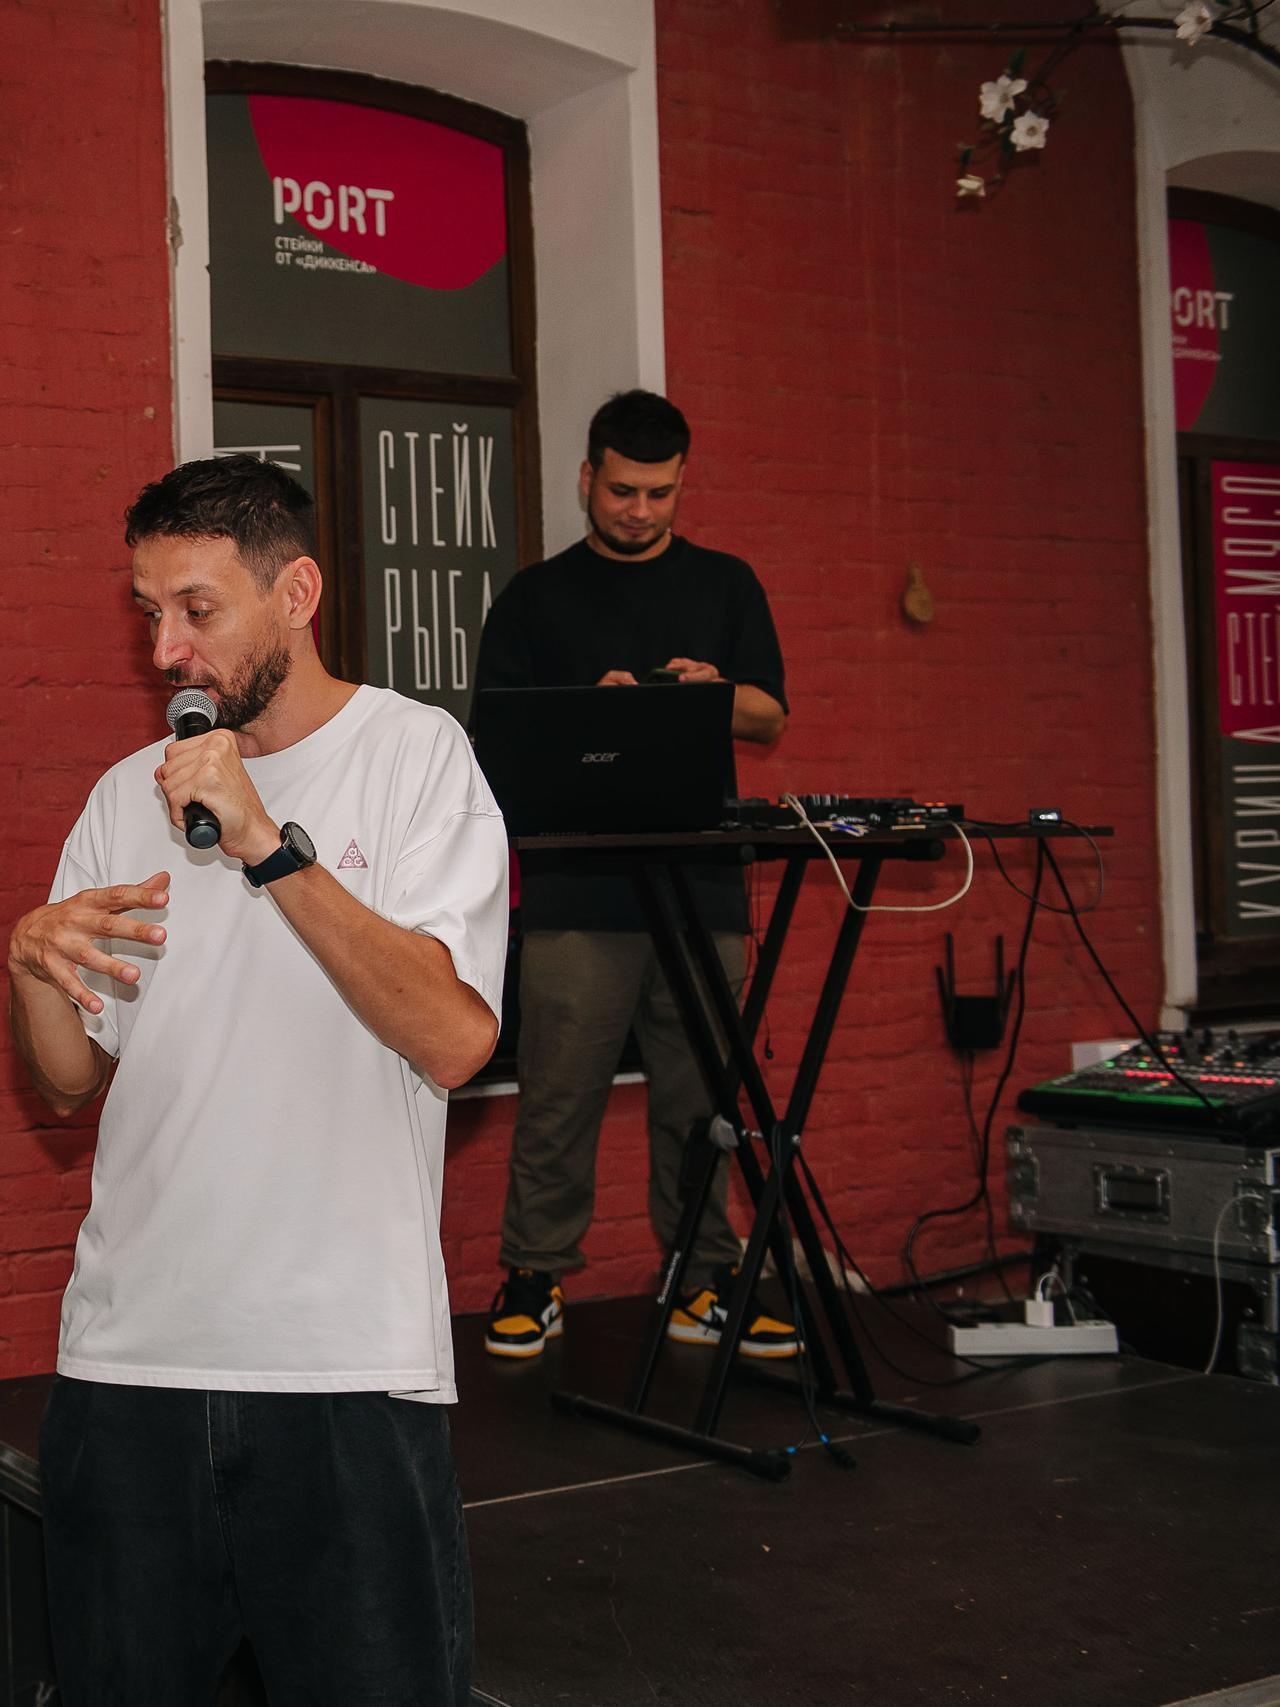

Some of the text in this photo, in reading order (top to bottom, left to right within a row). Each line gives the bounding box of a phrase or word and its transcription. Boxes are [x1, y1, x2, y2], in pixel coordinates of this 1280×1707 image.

[273, 176, 395, 237] PORT
[275, 251, 293, 266] ОТ
[1172, 286, 1234, 331] ORT
[378, 422, 497, 548] СТЕЙК
[1227, 603, 1280, 706] СТЕ
[582, 752, 621, 763] acer
